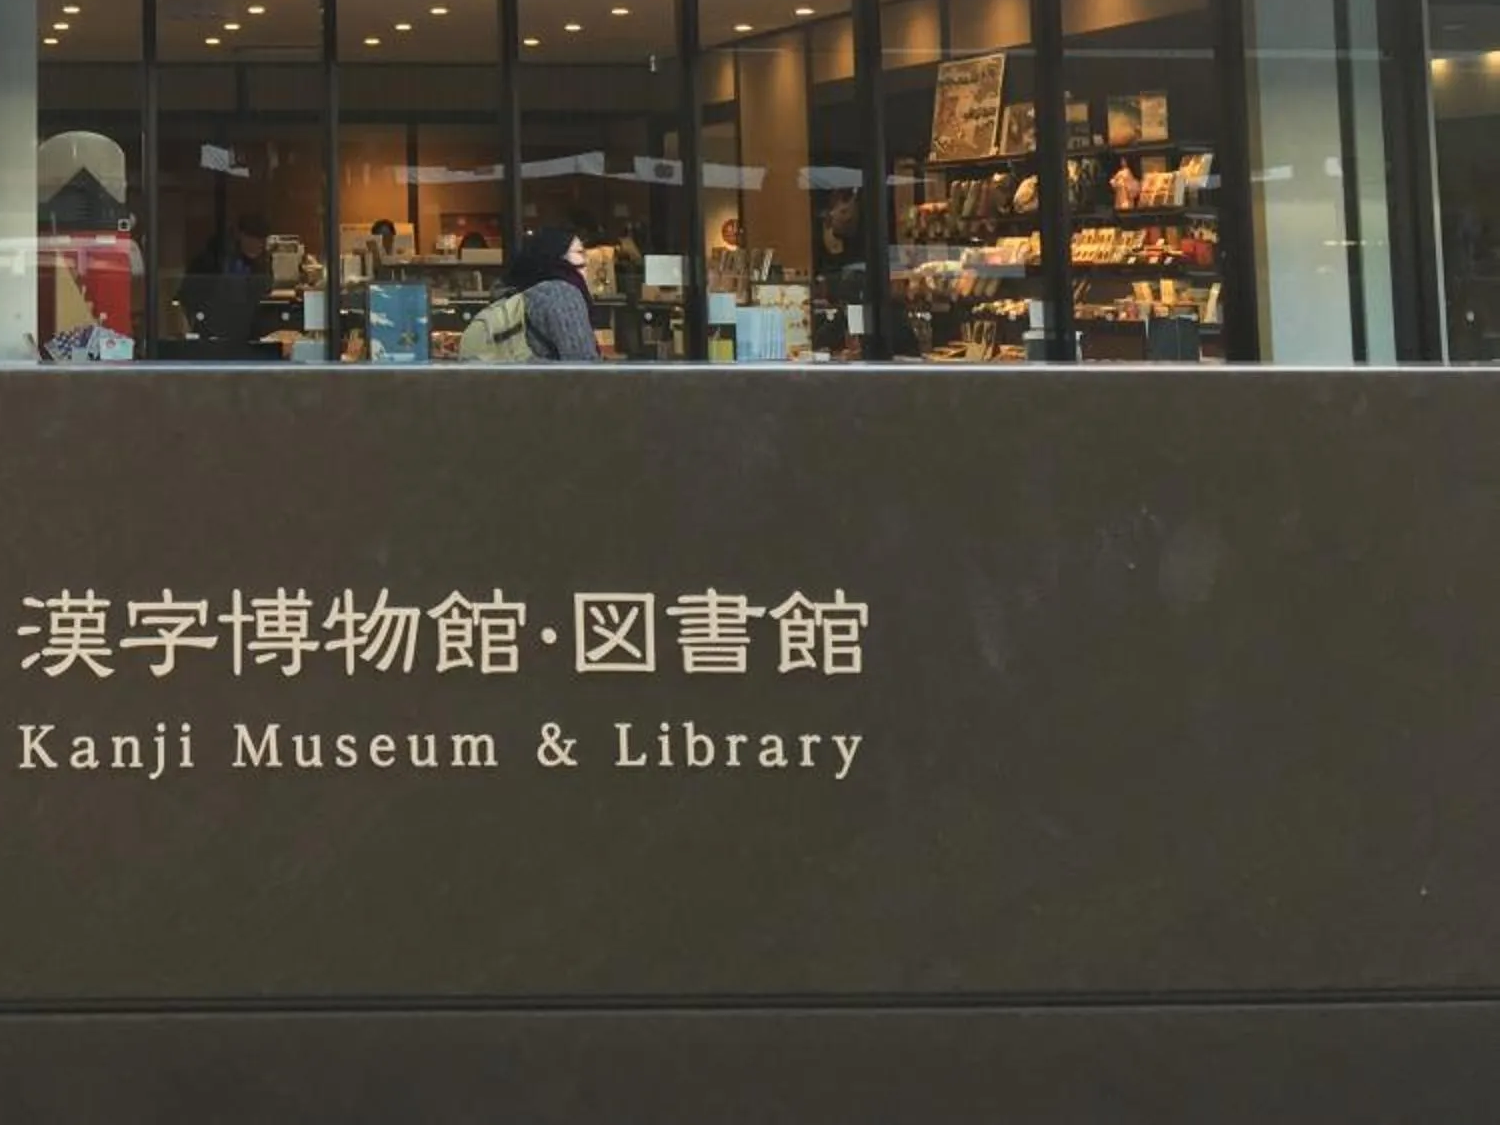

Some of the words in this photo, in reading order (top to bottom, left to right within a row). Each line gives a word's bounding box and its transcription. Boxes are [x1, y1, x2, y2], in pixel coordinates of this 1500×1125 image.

[18, 722, 195, 780] Kanji
[232, 723, 498, 767] Museum
[536, 722, 578, 767] &
[615, 721, 863, 780] Library
